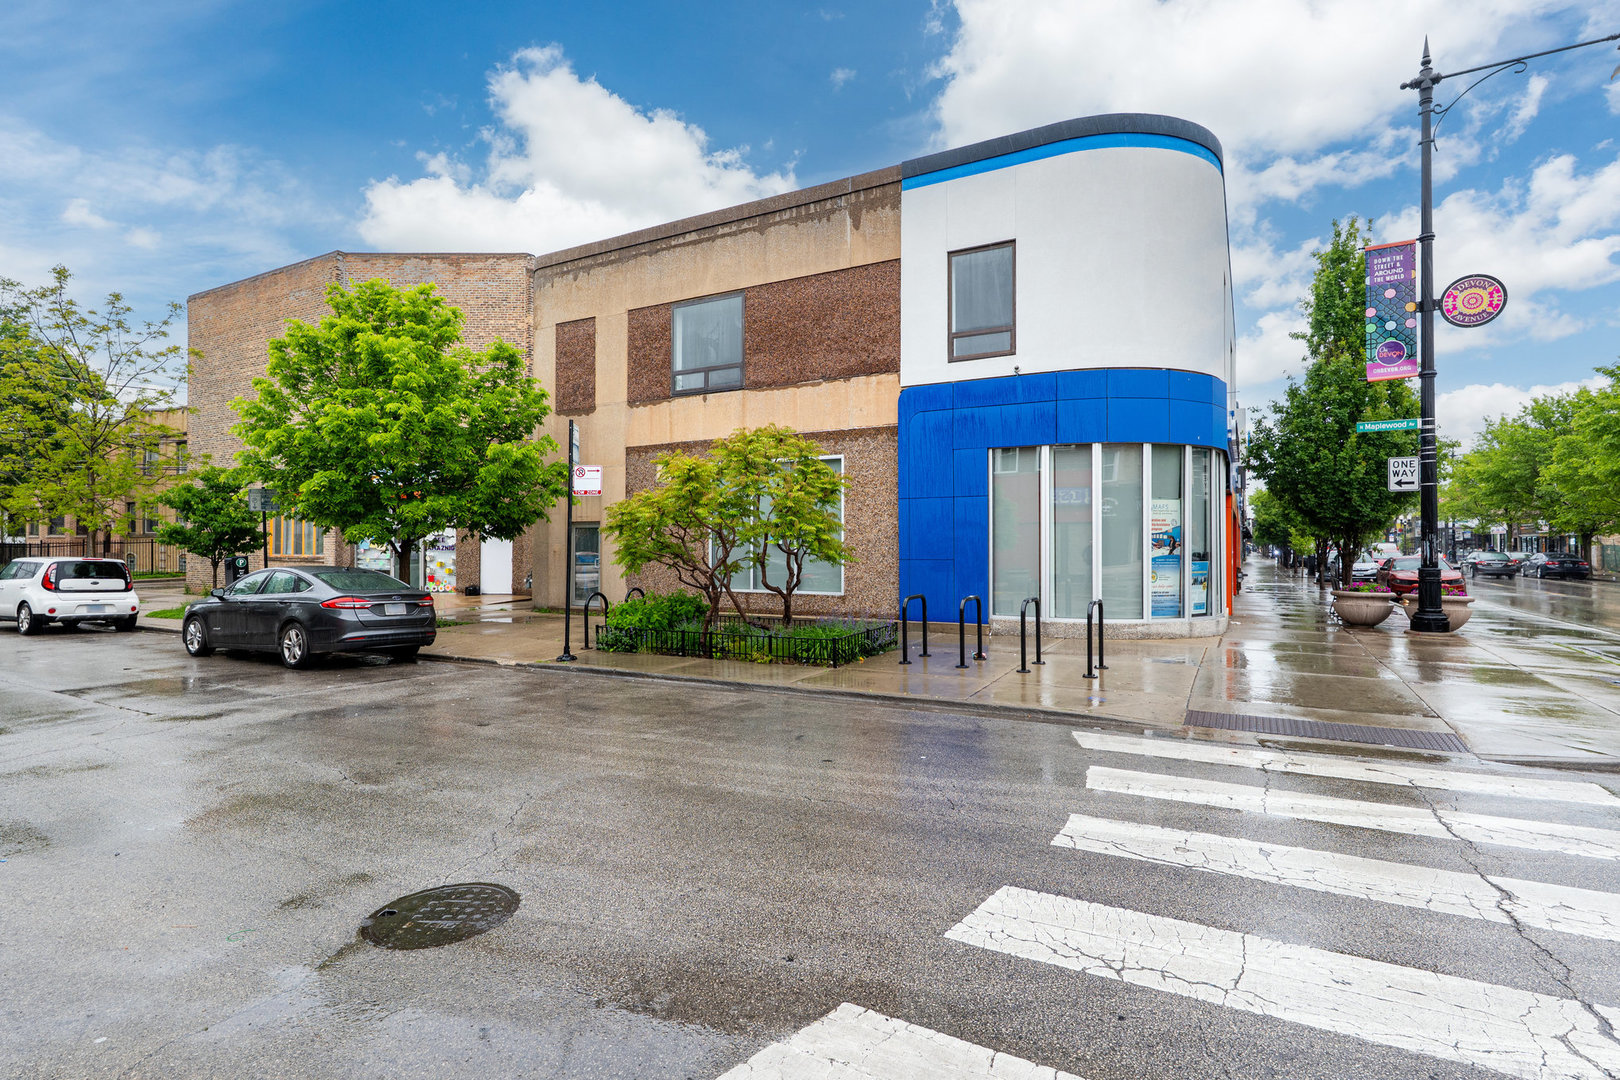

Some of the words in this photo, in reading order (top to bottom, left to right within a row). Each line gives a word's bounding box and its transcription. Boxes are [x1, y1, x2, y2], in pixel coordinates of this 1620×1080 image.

[1374, 262, 1394, 270] STREET
[1374, 268, 1404, 277] AROUND
[1456, 279, 1491, 292] DEVON
[1453, 312, 1490, 323] AVENUE
[1379, 350, 1403, 358] DEVON
[1364, 422, 1406, 430] Maplewood
[1392, 460, 1416, 468] ONE
[1392, 469, 1416, 478] WAY
